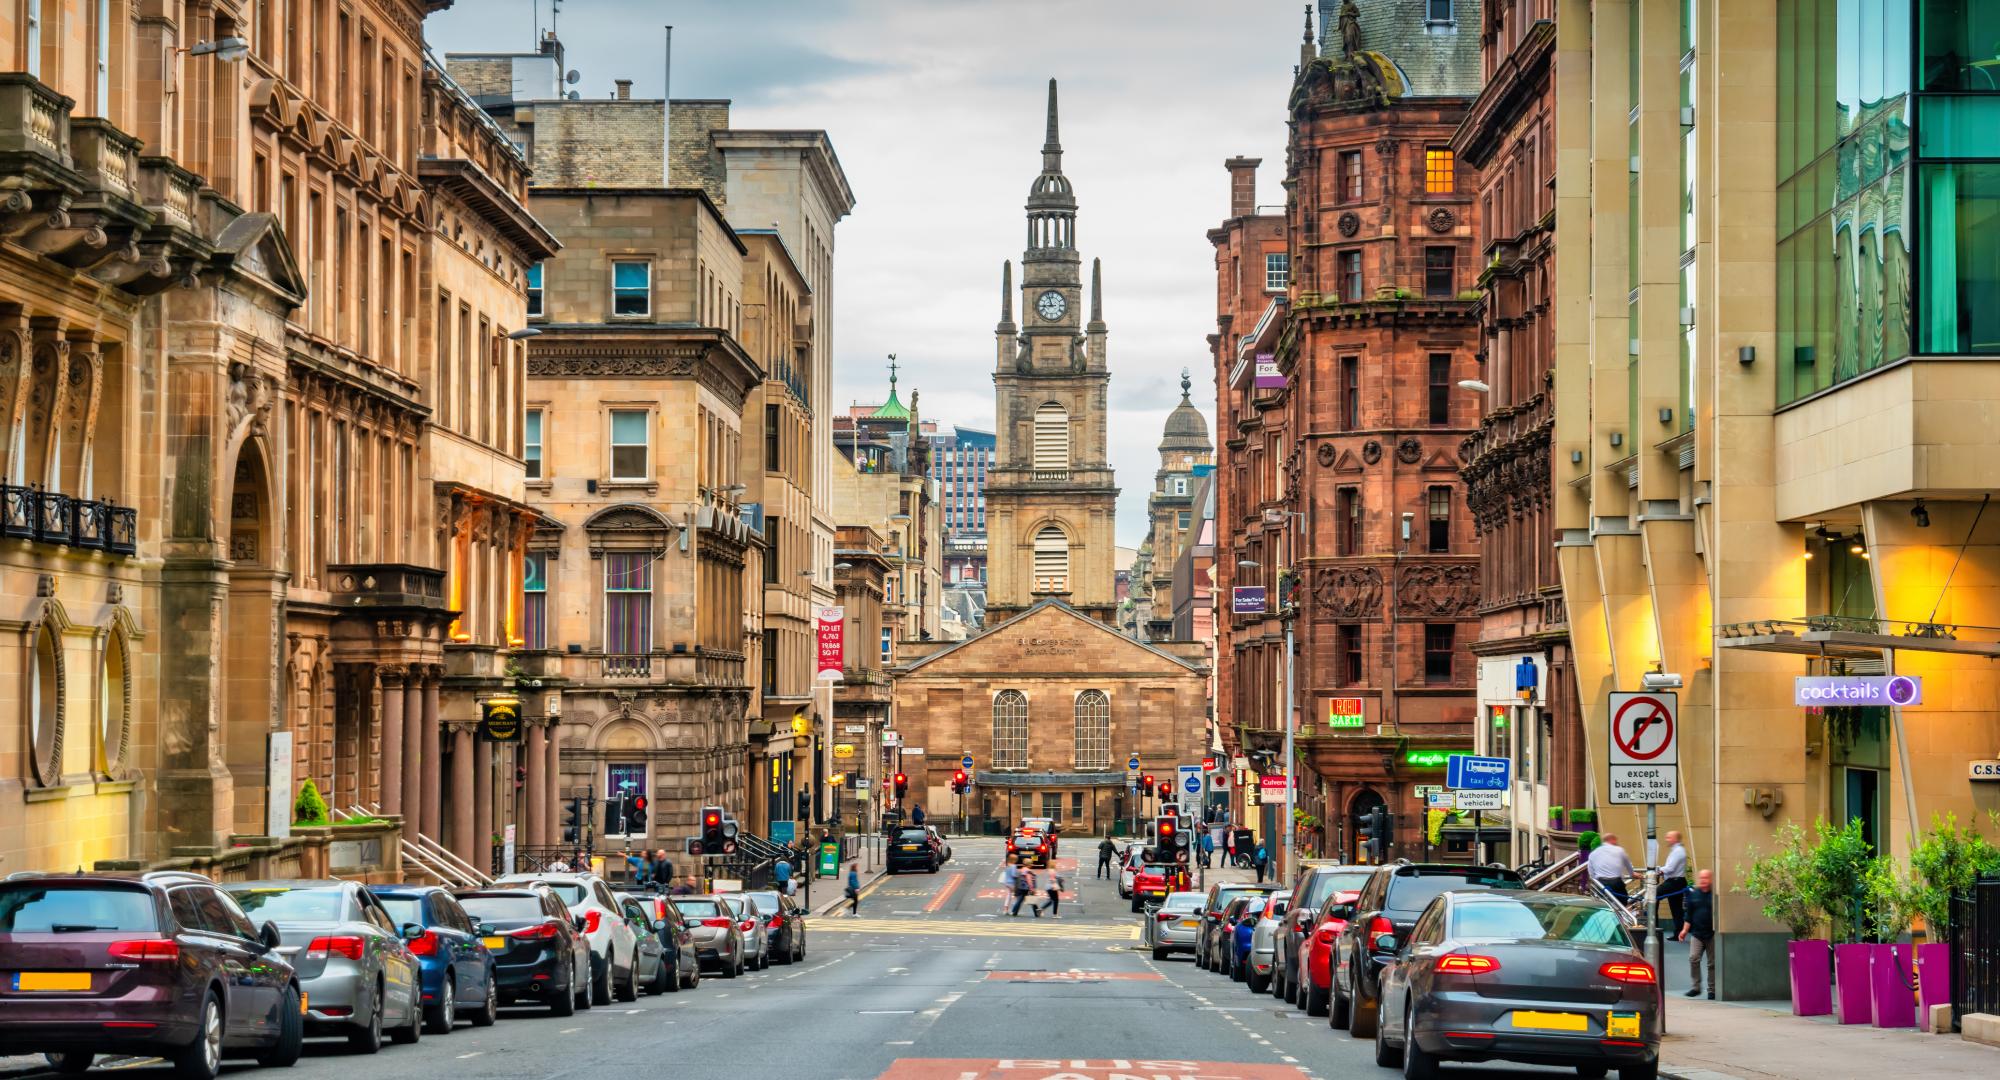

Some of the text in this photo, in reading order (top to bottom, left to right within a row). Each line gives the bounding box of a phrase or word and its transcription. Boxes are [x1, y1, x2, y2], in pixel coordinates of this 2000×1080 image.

[1800, 682, 1879, 699] cocktails
[1331, 715, 1363, 726] SARTI
[1627, 769, 1660, 778] except
[1470, 777, 1484, 785] taxi
[1649, 778, 1673, 788] taxis
[1640, 791, 1669, 801] cycles
[1463, 799, 1494, 807] vehicles
[997, 1059, 1201, 1071] BUS
